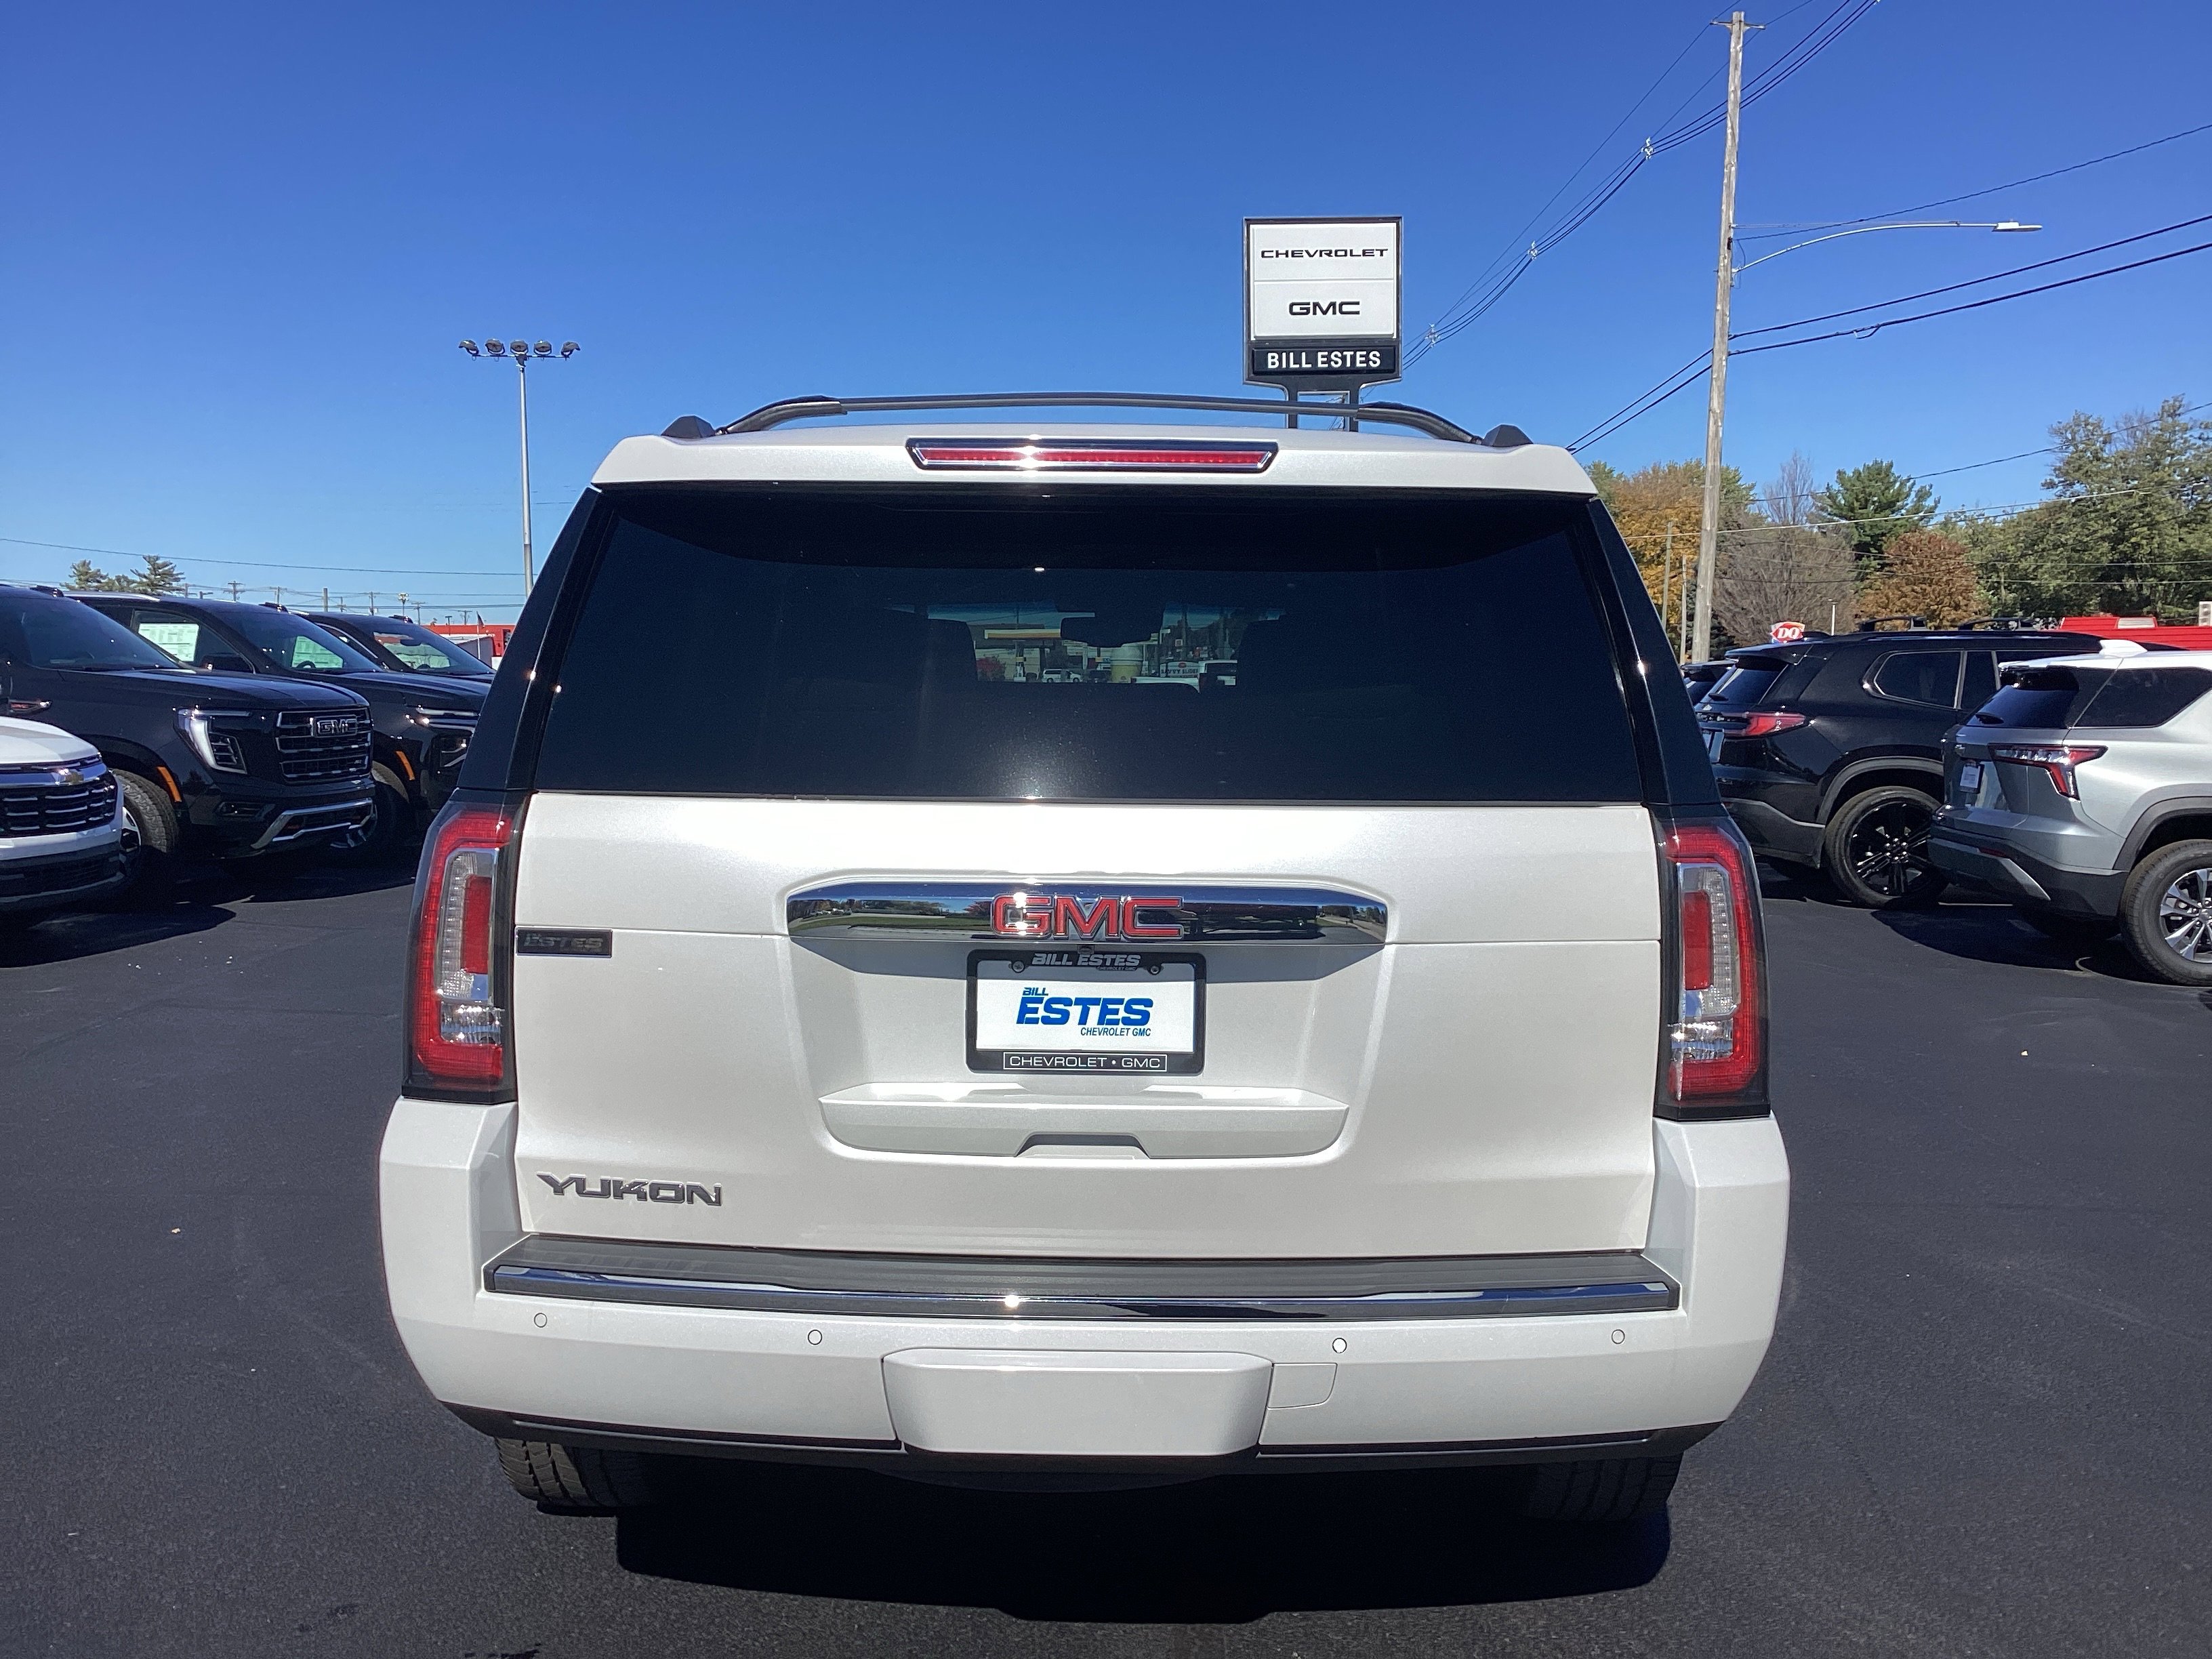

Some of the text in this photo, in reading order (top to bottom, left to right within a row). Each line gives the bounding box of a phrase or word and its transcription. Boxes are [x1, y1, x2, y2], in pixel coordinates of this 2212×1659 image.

[1261, 248, 1389, 258] CHEVROLET
[1288, 301, 1360, 316] GMC
[1267, 350, 1381, 369] BILL ESTES
[1777, 627, 1801, 639] DQ
[316, 718, 357, 735] GMC
[991, 894, 1185, 939] GMC
[524, 936, 603, 948] ESTES
[1031, 953, 1141, 966] BILL ESTES
[1022, 987, 1049, 996] BILL
[1016, 996, 1153, 1026] ESTES
[1080, 1027, 1151, 1037] CHEVROLET GMC
[1010, 1056, 1160, 1068] CHEVROLET GMC
[536, 1171, 722, 1206] YUKON
